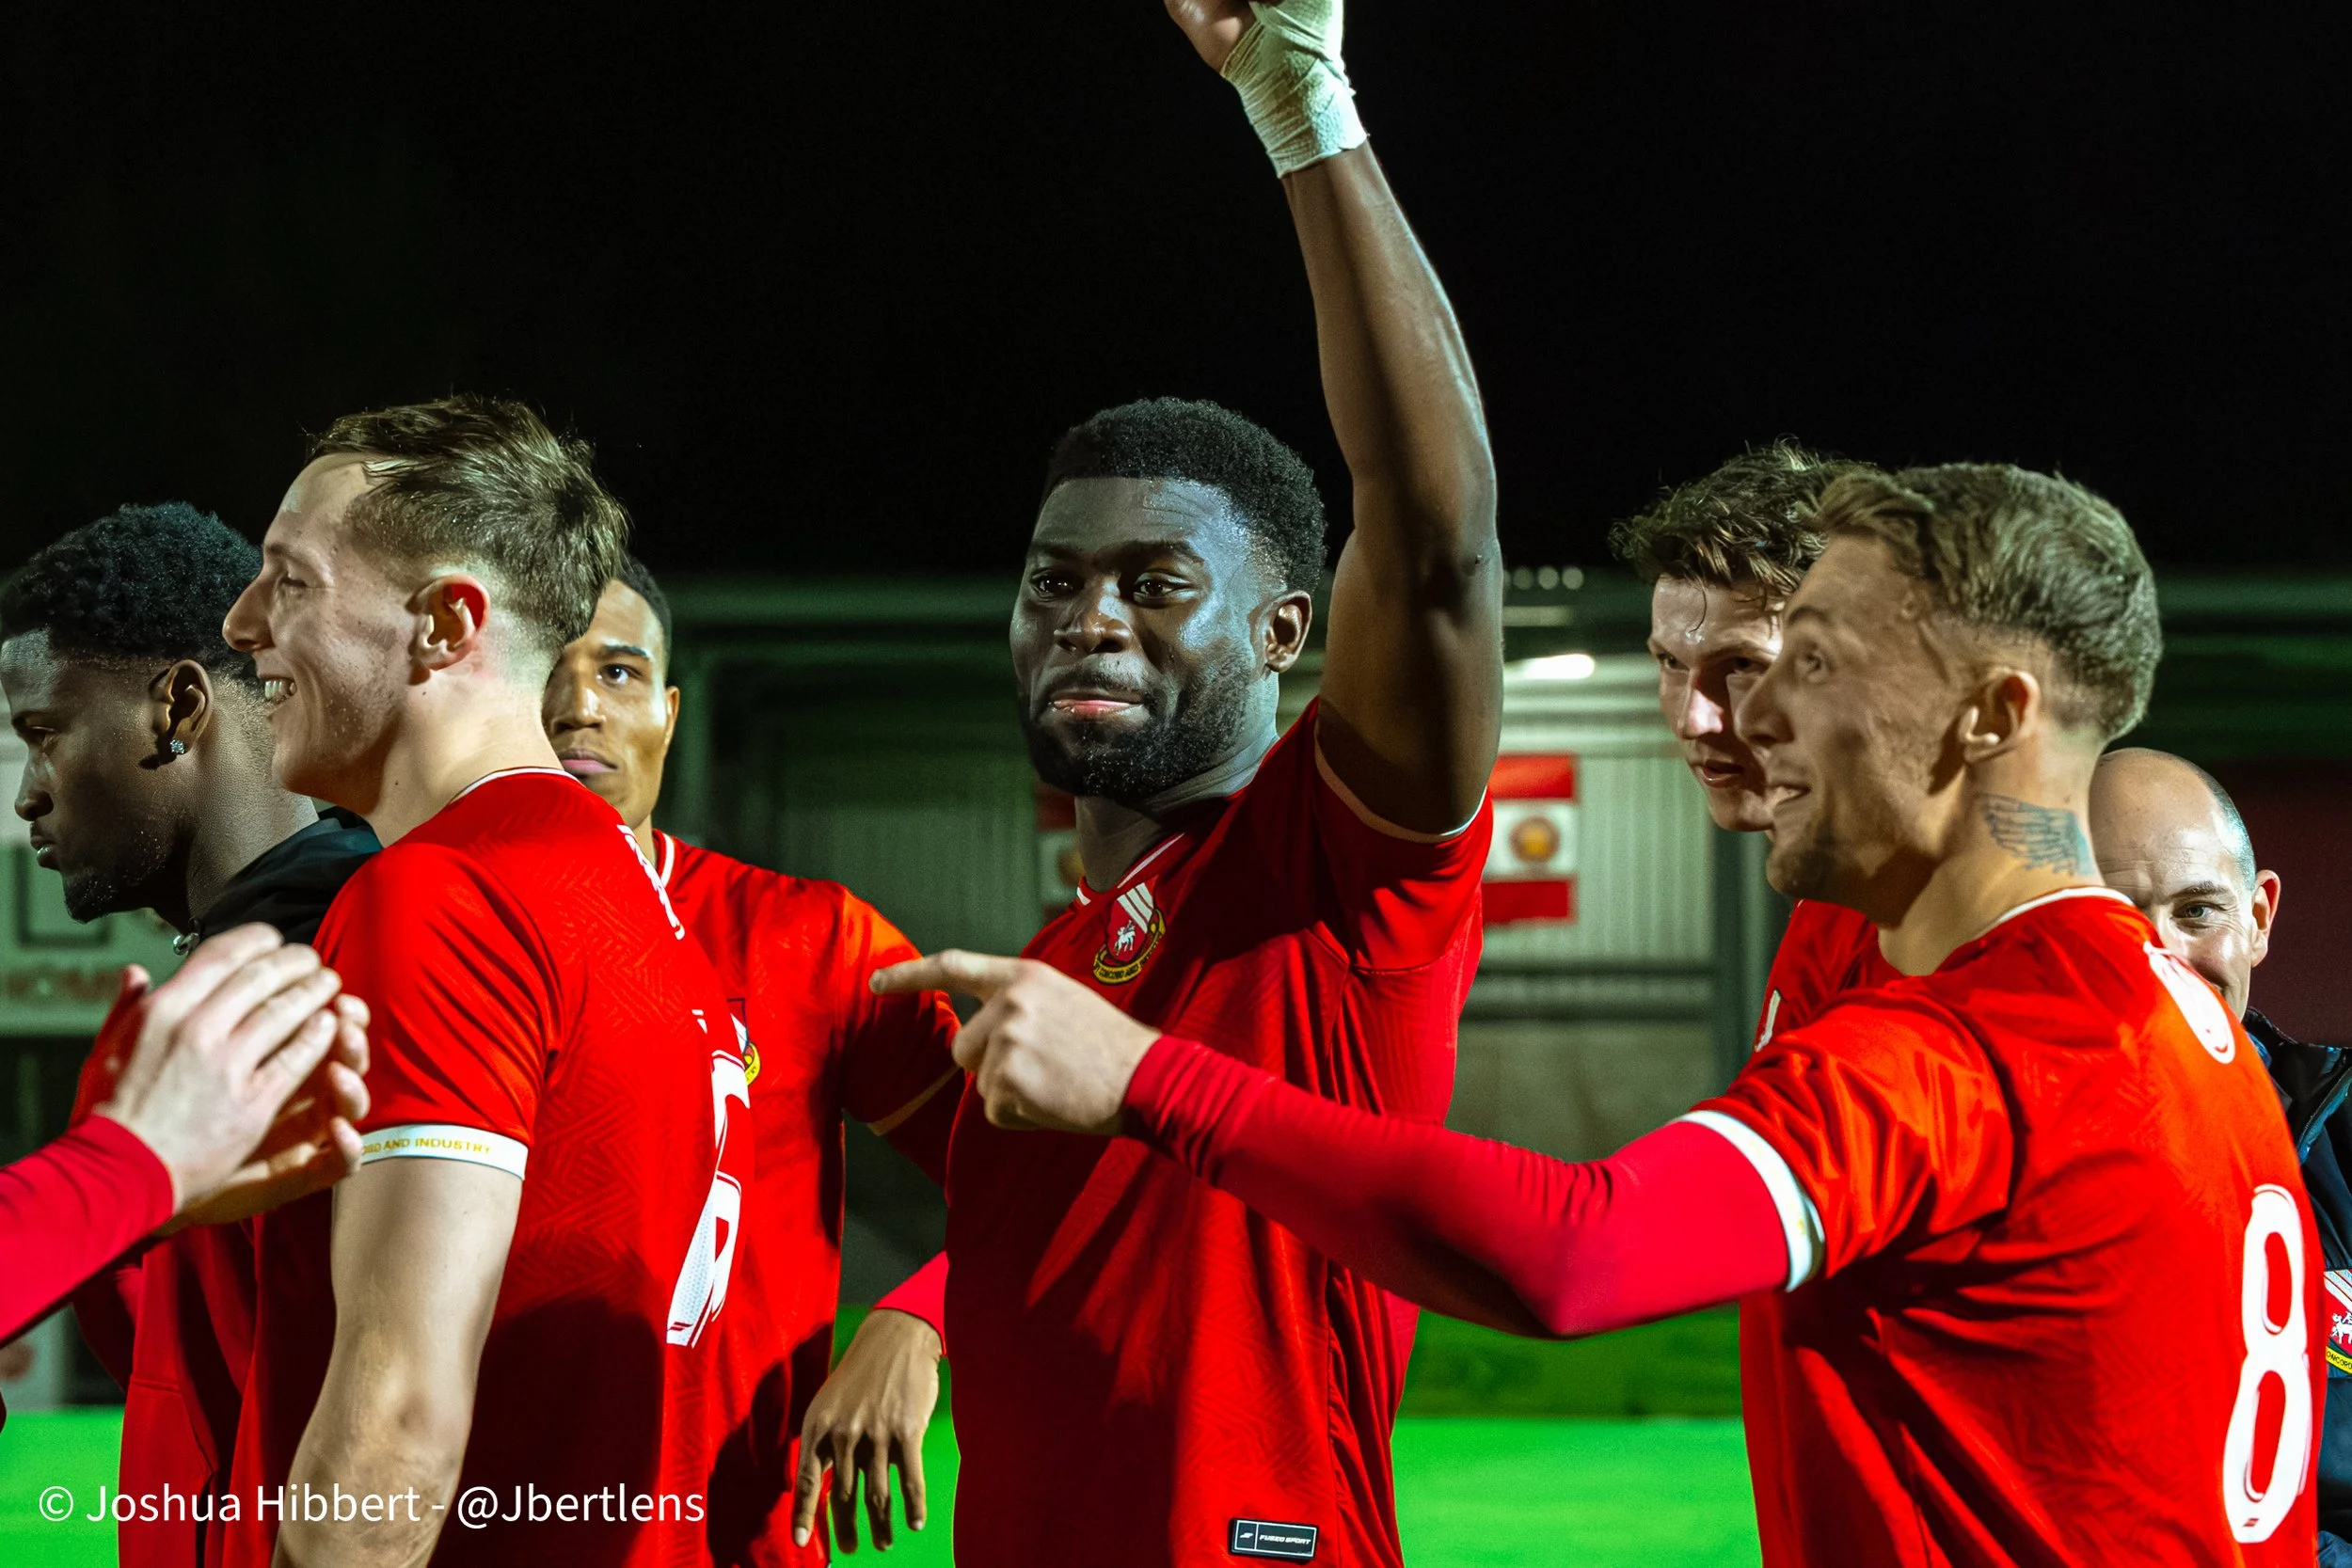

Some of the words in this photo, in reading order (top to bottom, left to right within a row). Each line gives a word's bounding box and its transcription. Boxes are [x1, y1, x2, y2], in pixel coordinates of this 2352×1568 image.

[384, 1138, 410, 1150] AND
[415, 1137, 491, 1154] INDUSTRY
[2223, 1184, 2312, 1543] 8
